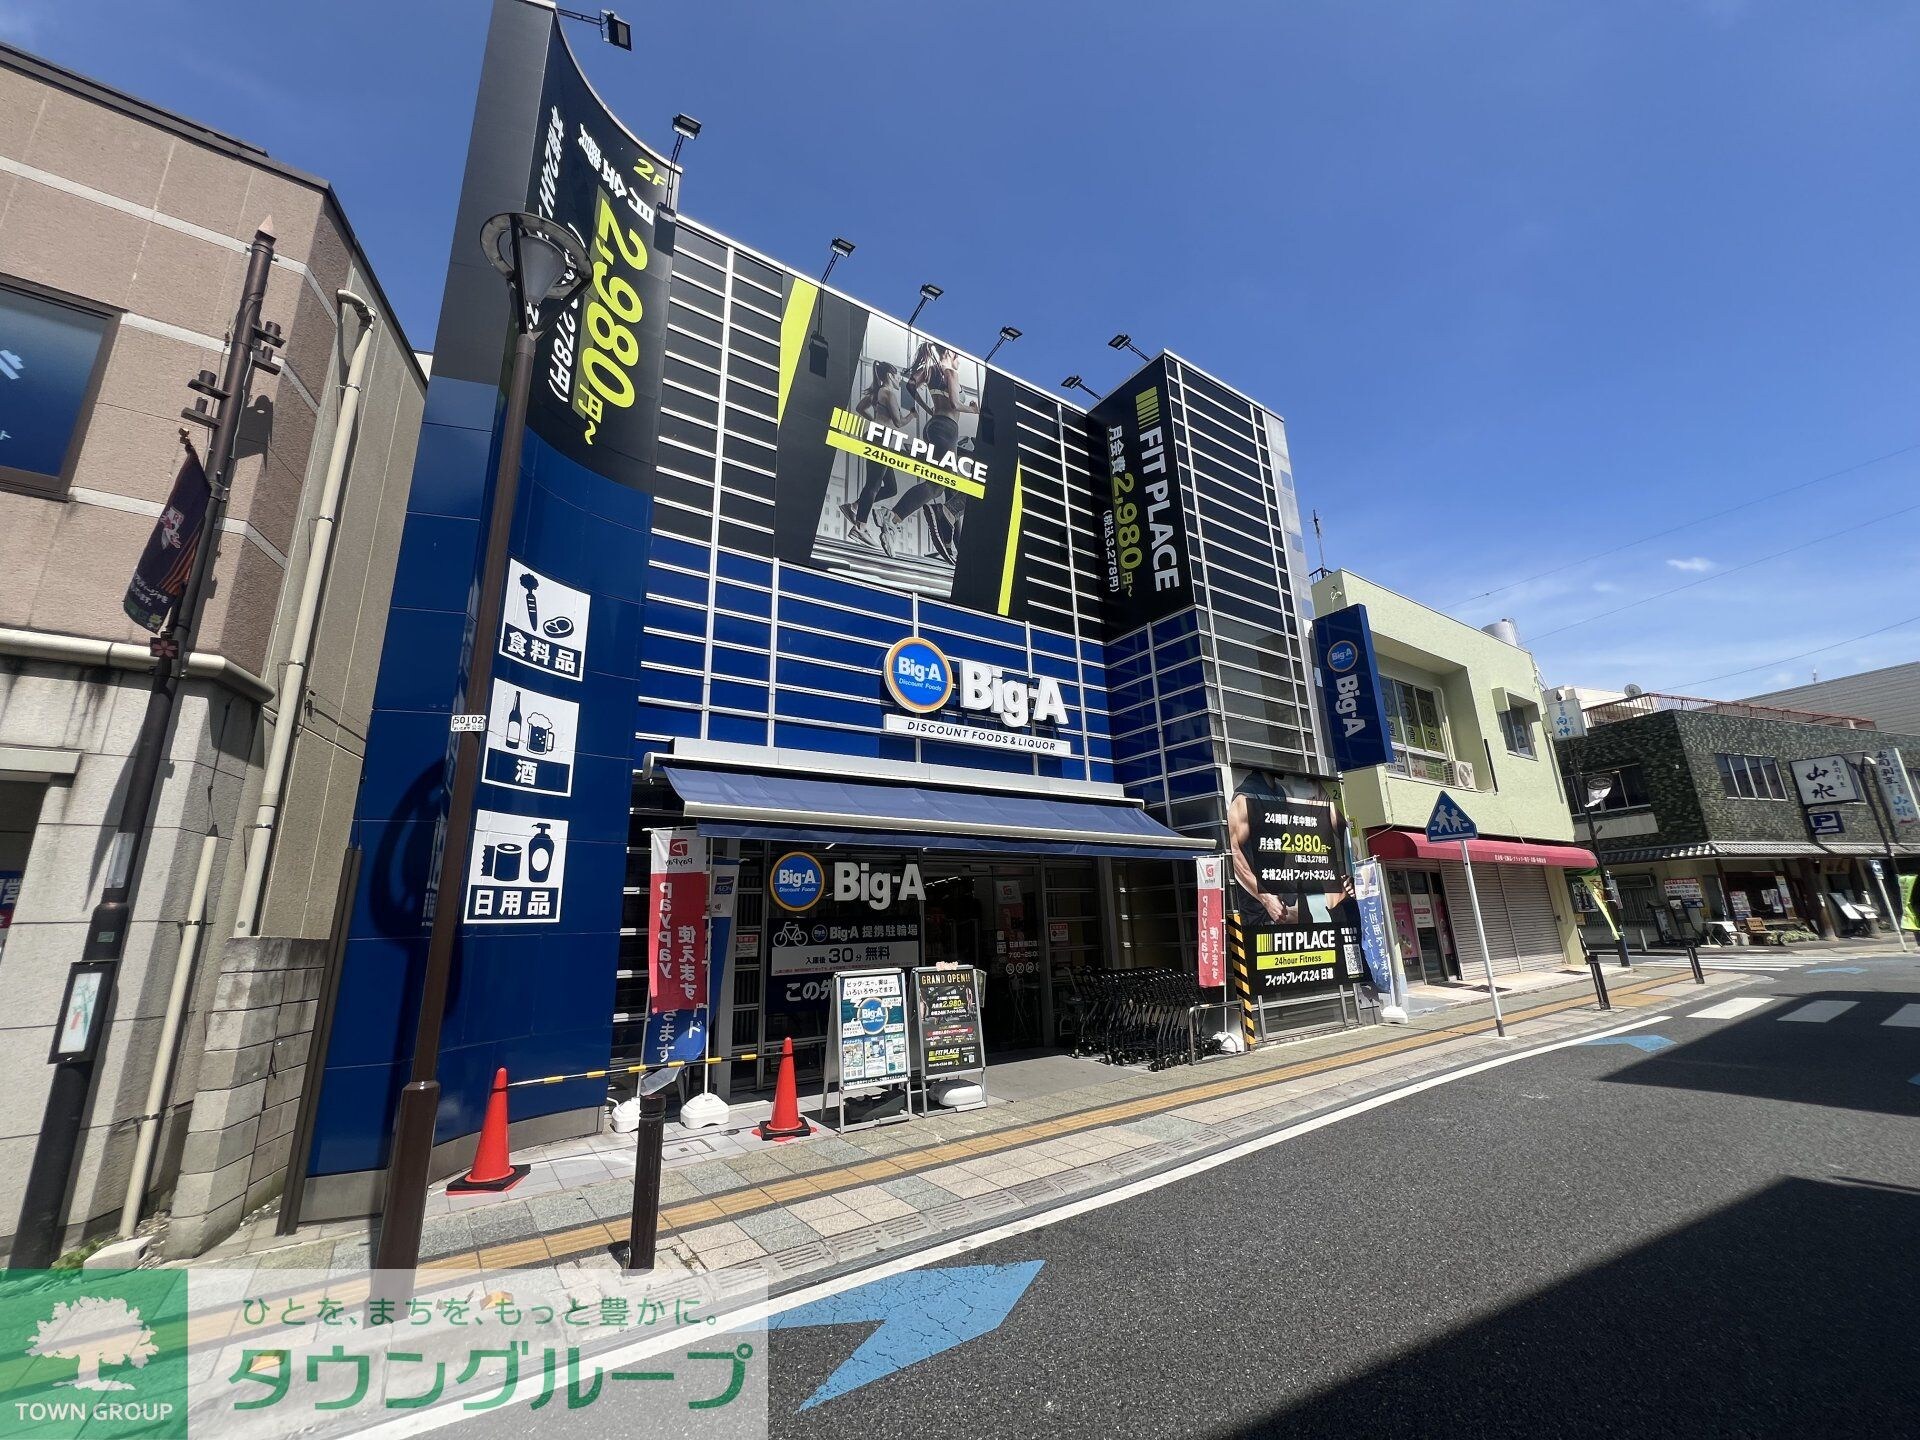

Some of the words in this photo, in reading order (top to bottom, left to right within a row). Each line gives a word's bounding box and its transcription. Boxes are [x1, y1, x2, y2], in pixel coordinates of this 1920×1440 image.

[633, 158, 666, 186] 2F
[866, 421, 908, 452] FIT
[910, 437, 988, 483] PLACE
[1139, 426, 1167, 475] FIT
[862, 446, 910, 470] 24hour
[913, 461, 957, 487] Fitness
[1145, 479, 1180, 593] PLACE
[506, 629, 577, 674] 食料品
[1331, 647, 1352, 661] Big-A
[898, 656, 942, 682] Big-A
[898, 678, 924, 688] Discount
[924, 682, 942, 692] Foods
[959, 658, 1069, 727] Big-A
[454, 716, 484, 724] 50102
[1335, 674, 1366, 738] Big-A
[907, 721, 968, 738] DISCOUNT
[971, 731, 1008, 745] FOODS
[1018, 736, 1056, 751] LIQUOR
[514, 758, 538, 786] 酒
[1806, 763, 1837, 799] 山水
[779, 869, 816, 888] Big-A
[834, 861, 927, 910] Big-A
[473, 889, 552, 917] 日用品
[829, 926, 859, 941] Big-A
[862, 924, 918, 938] 提携駐輪場
[1274, 932, 1294, 952] FIT
[1295, 930, 1336, 951] PLACE
[1274, 957, 1298, 966] 24hour
[1299, 954, 1322, 964] Fitness
[921, 974, 946, 985] GRAND
